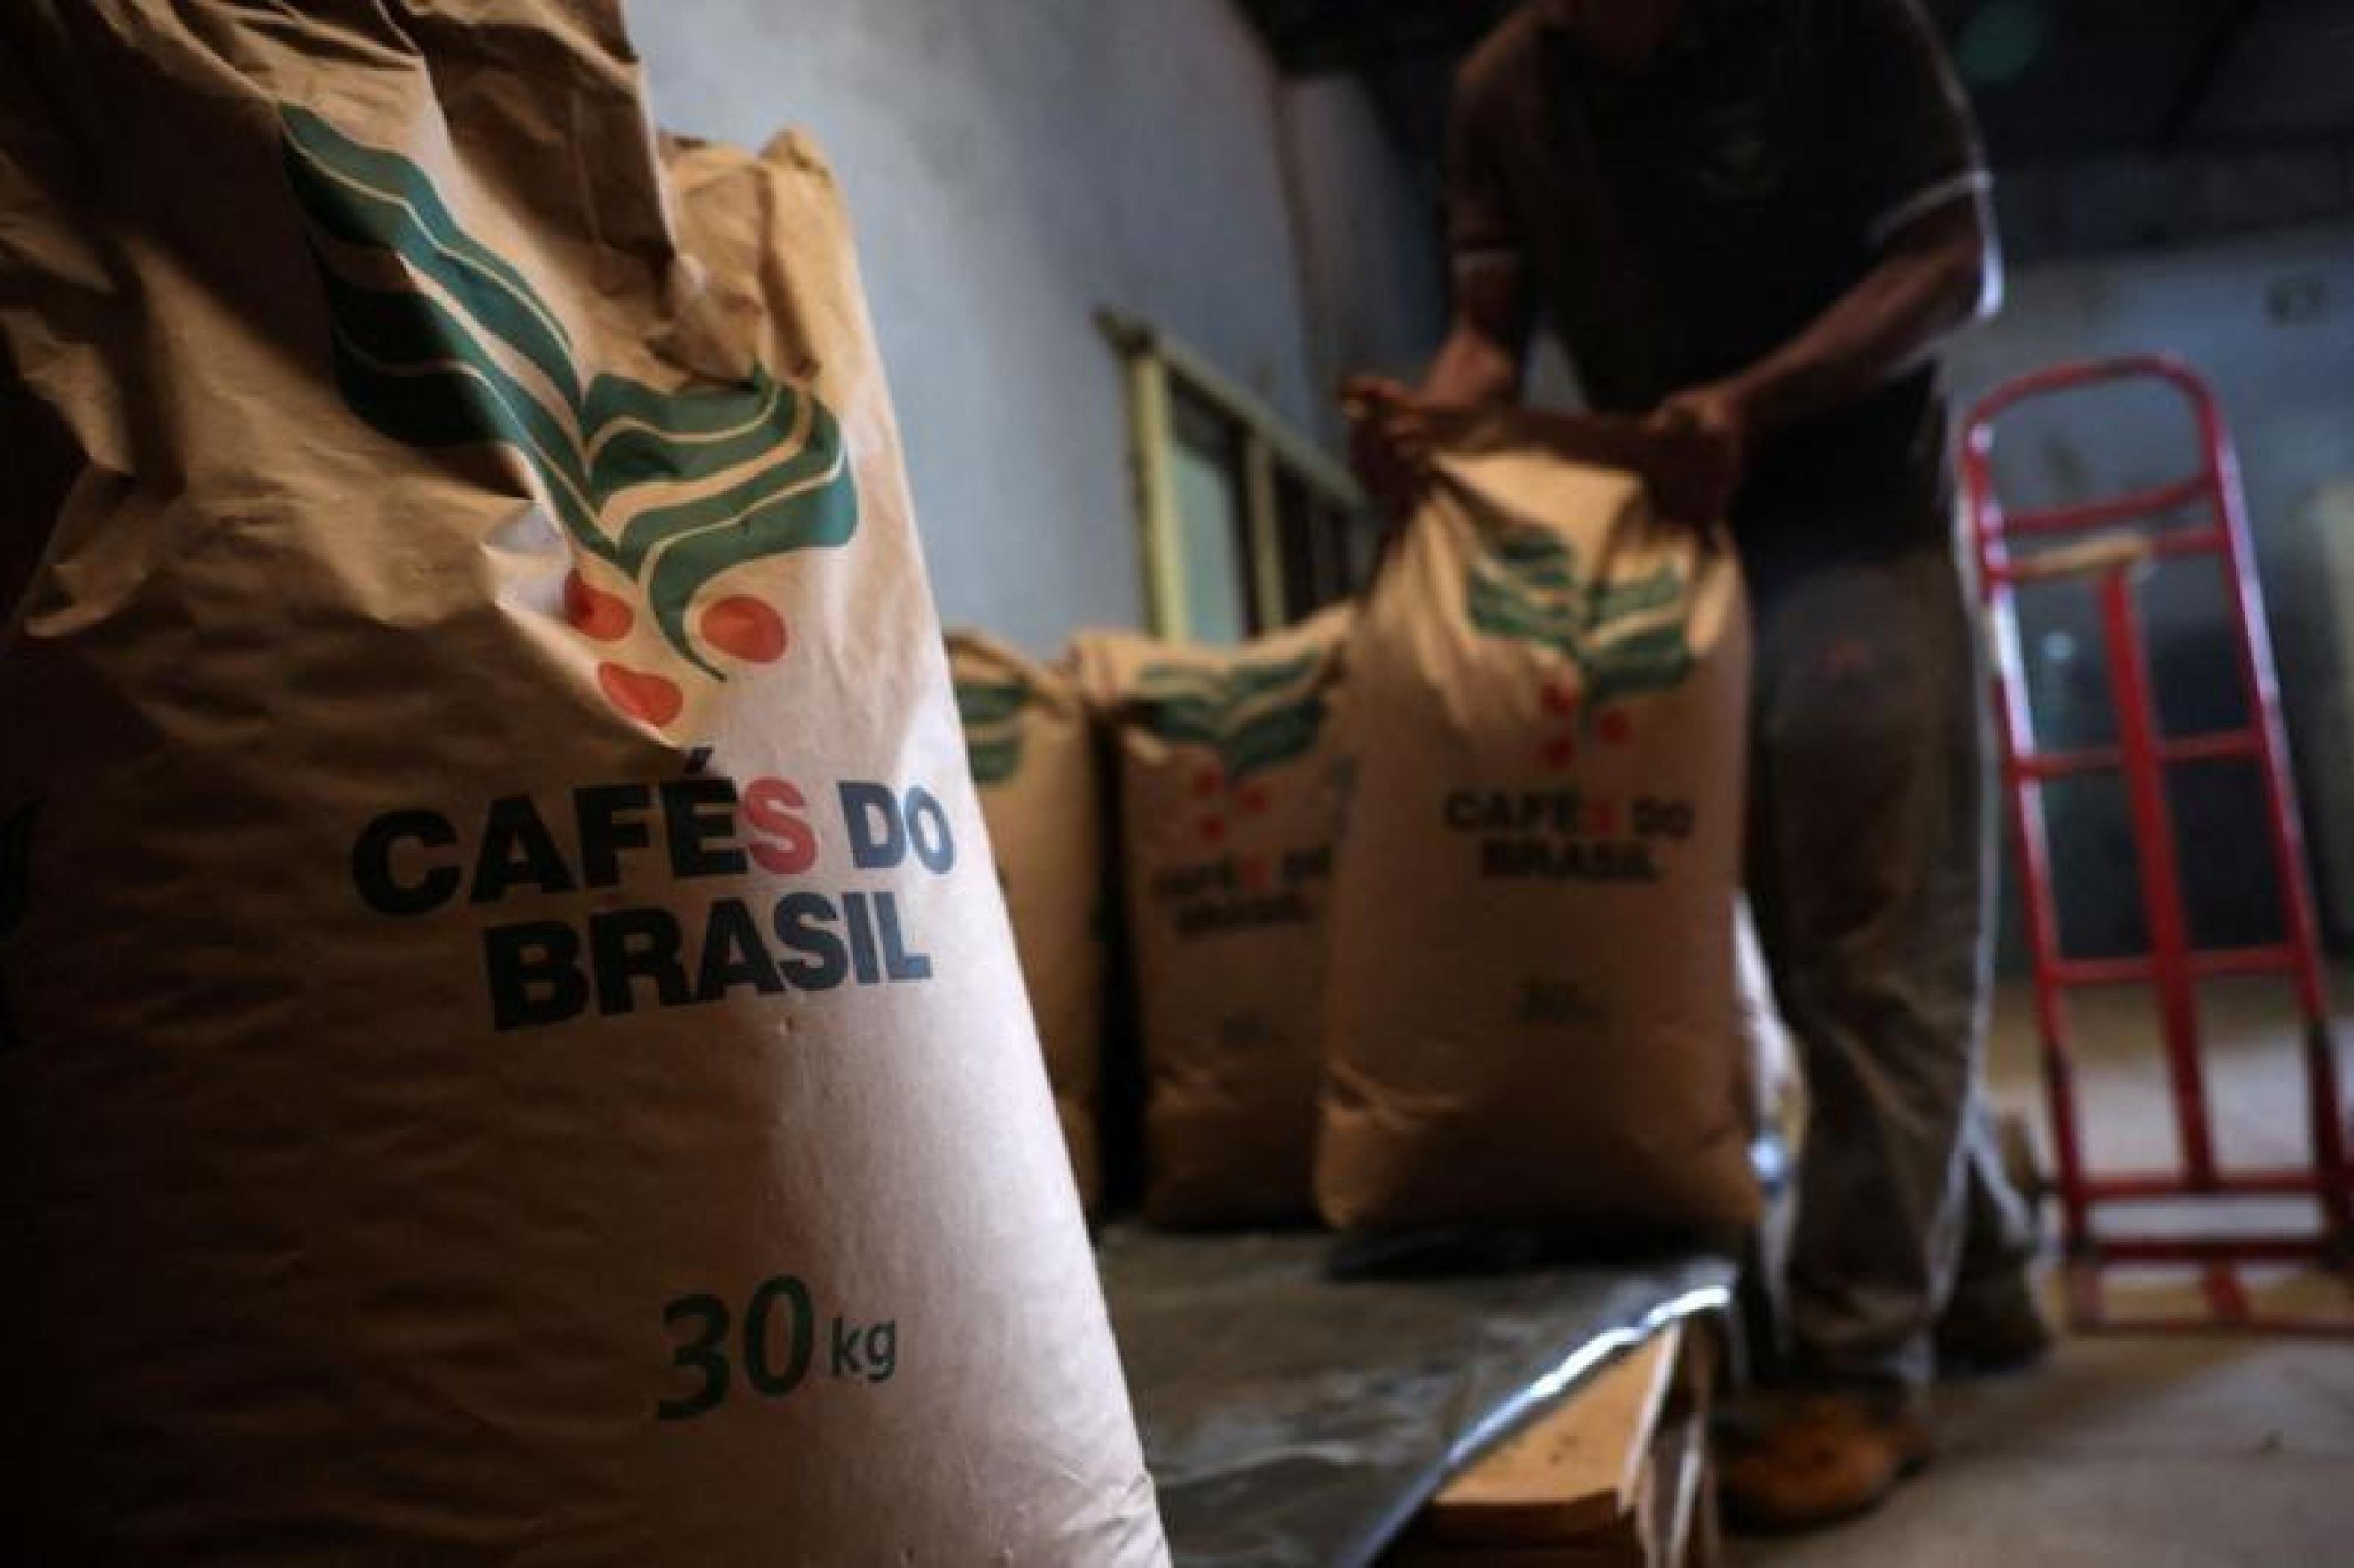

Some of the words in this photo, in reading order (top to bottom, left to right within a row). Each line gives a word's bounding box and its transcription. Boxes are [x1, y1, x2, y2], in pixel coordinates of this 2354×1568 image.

[351, 747, 818, 916] CAFÉS
[837, 778, 956, 875] DO
[483, 891, 933, 1030] BRASIL
[658, 1275, 815, 1419] 30
[831, 1314, 897, 1383] kg
